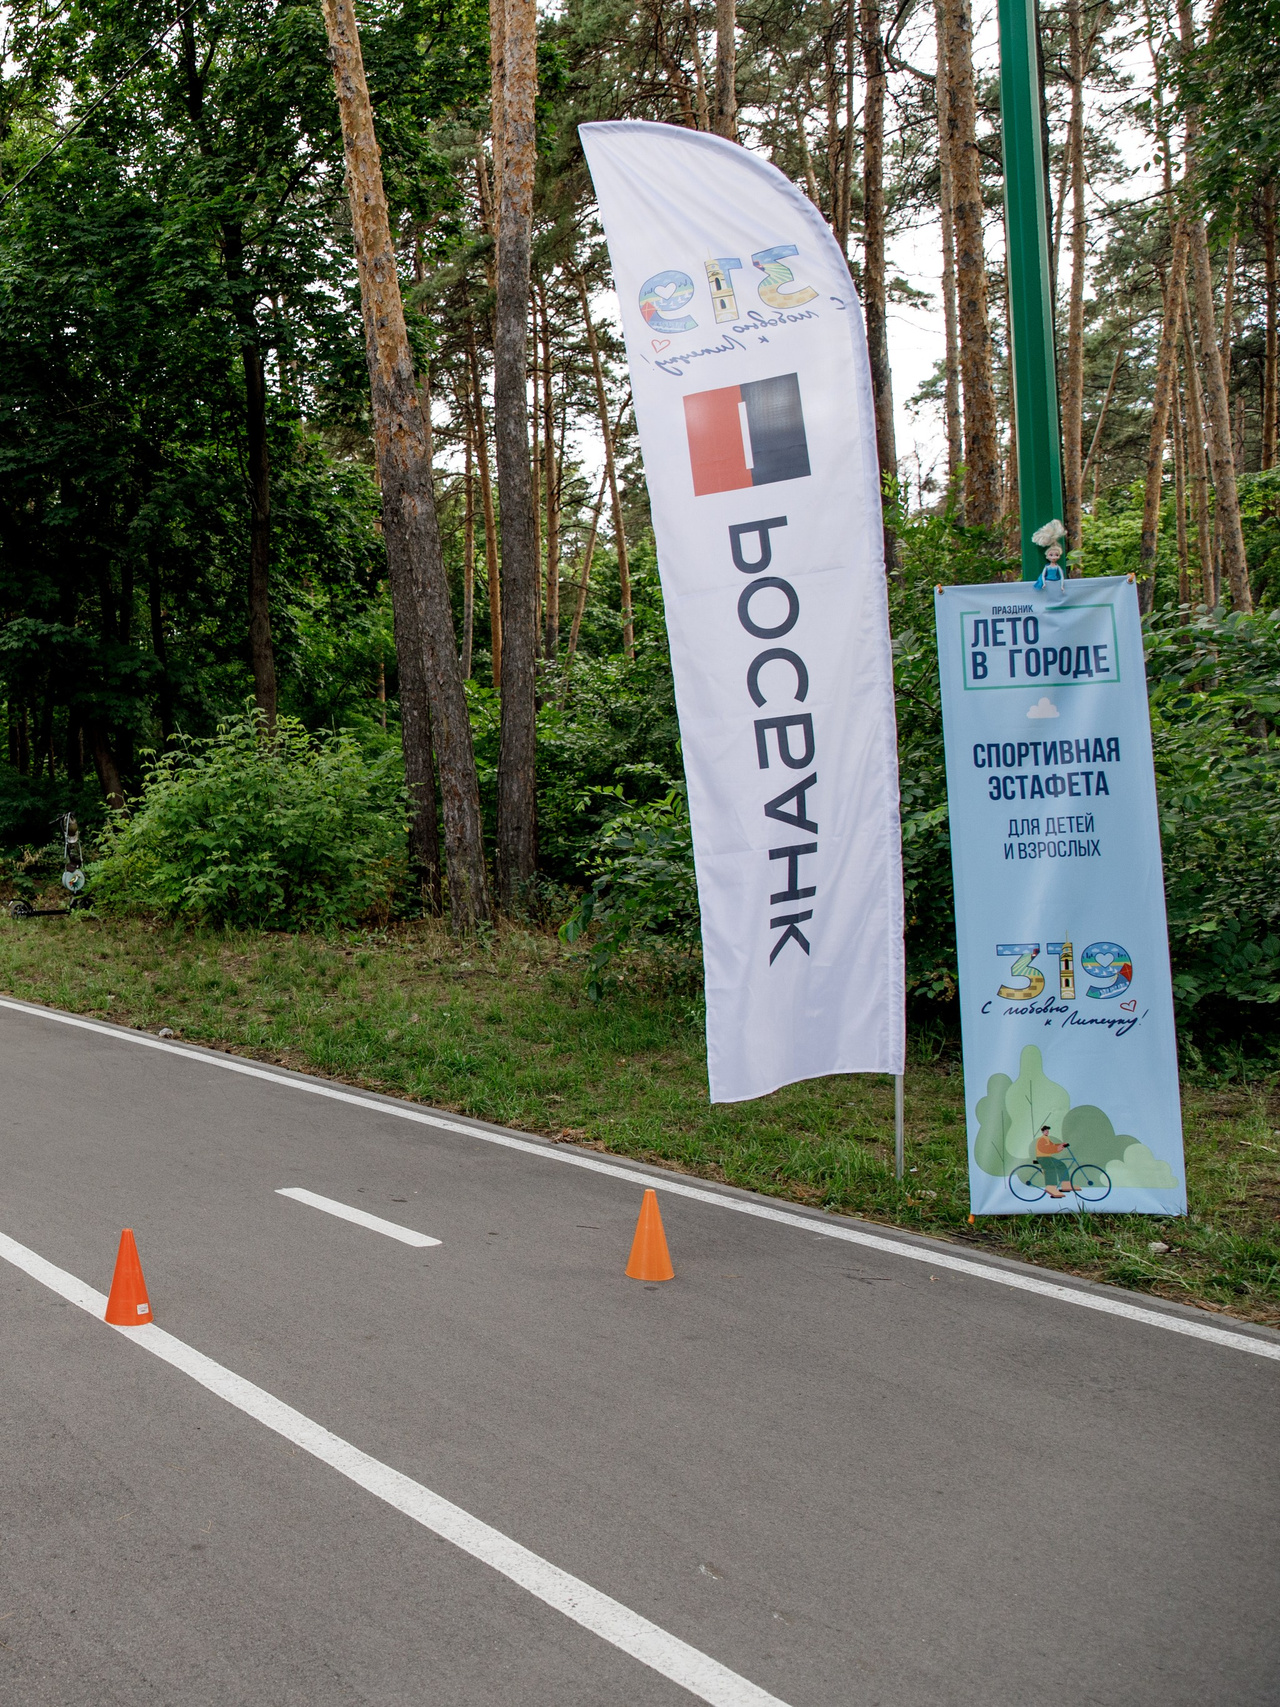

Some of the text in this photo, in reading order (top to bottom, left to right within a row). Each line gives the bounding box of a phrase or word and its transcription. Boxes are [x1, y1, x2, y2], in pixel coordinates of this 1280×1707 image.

[992, 605, 1033, 615] ПРАЗДНИК
[971, 616, 1039, 648] ЛЕТО
[972, 644, 1110, 680] В ГОРОДЕ
[973, 737, 1121, 768] СПОРТИВНАЯ
[988, 770, 1110, 801] ЭСТАФЕТА
[1008, 812, 1095, 838] ДЛЯ ДЕТЕЙ
[1004, 839, 1101, 860] И ВЗРОСЛЫХ
[996, 934, 1133, 1001] 319
[1003, 996, 1069, 1016] любовью
[1062, 1009, 1149, 1037] Липецку!
